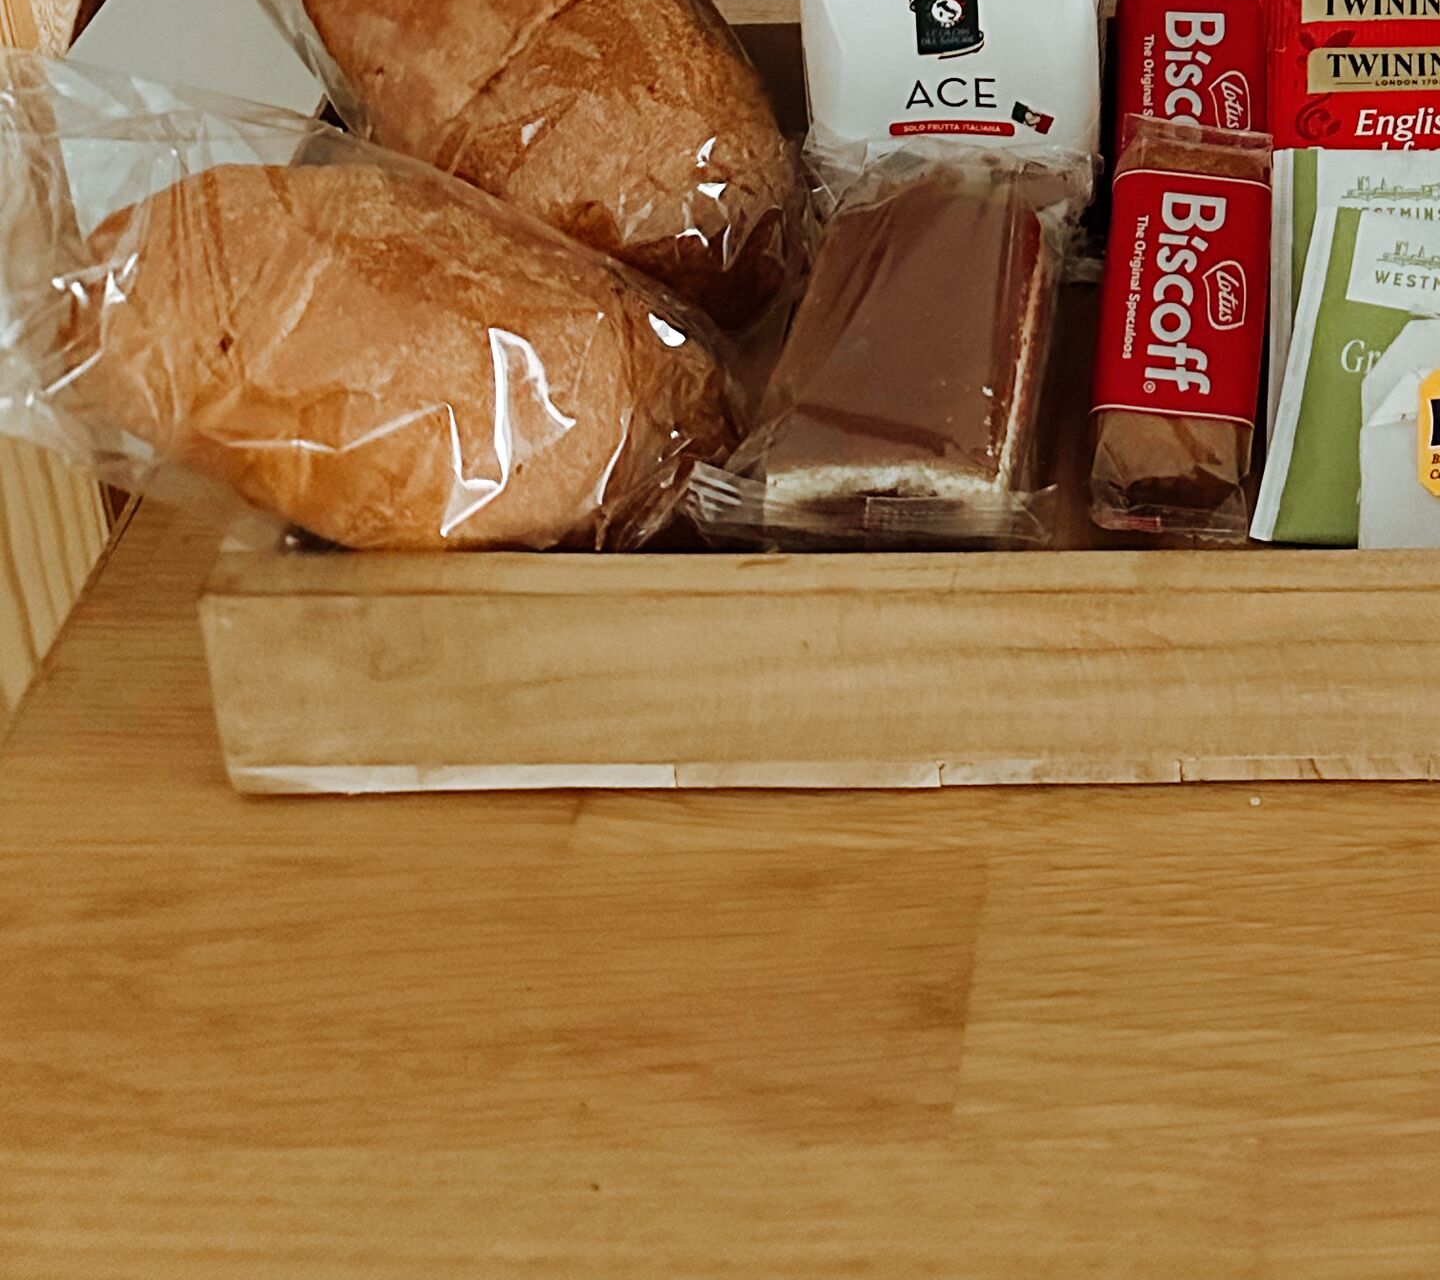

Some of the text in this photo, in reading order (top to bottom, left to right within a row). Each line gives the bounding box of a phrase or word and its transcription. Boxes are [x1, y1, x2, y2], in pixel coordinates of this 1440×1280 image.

[1143, 34, 1155, 57] The
[1140, 59, 1155, 107] Original
[1165, 11, 1226, 126] Bisc
[905, 77, 998, 110] ACE
[903, 123, 1001, 133] SOLO FRUTTA ITALIANA
[1122, 215, 1149, 360] The Original Speculoos
[1340, 339, 1382, 373] Gr
